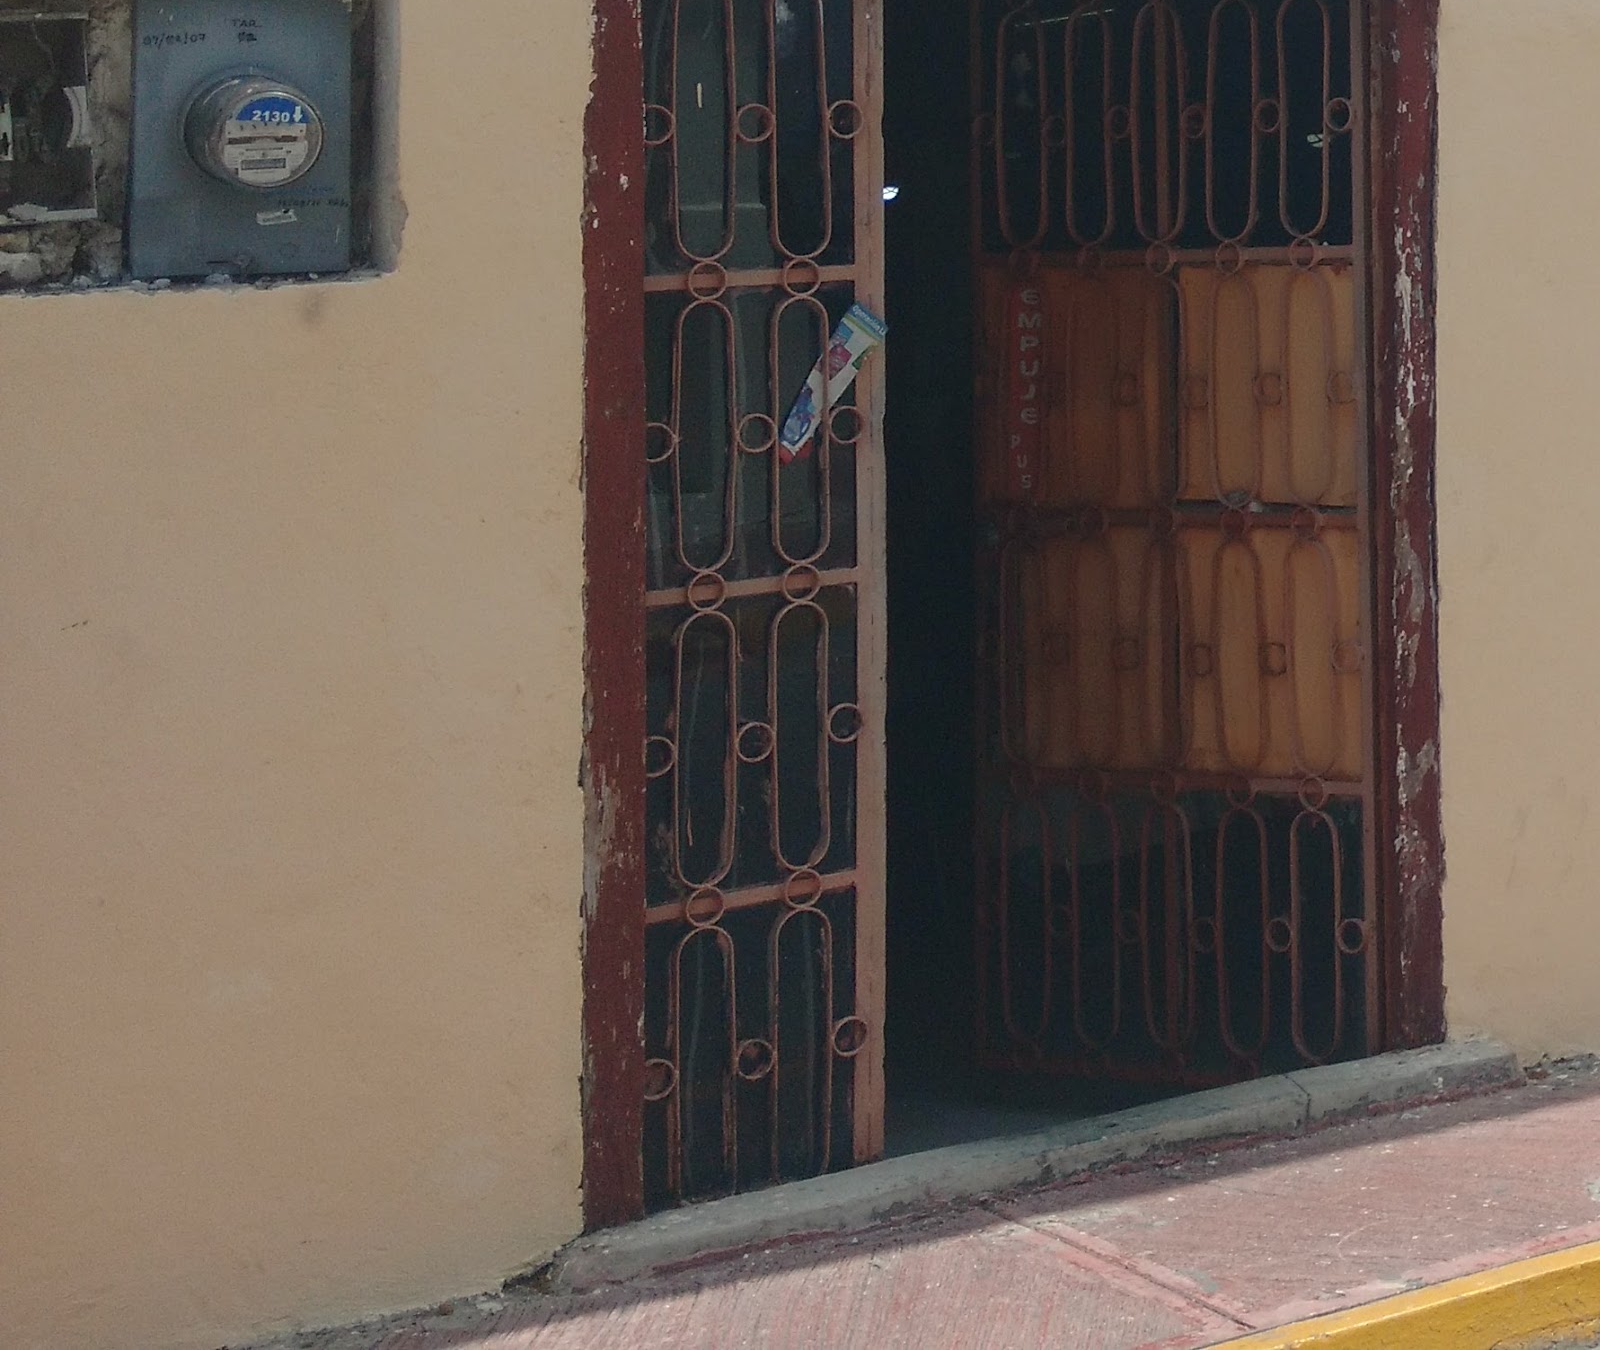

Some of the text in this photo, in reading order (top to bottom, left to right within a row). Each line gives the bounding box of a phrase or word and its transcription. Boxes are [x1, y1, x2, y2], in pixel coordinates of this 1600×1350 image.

[252, 110, 290, 123] 2130
[1018, 288, 1040, 425] EMPUJE
[1011, 434, 1037, 507] PUS
